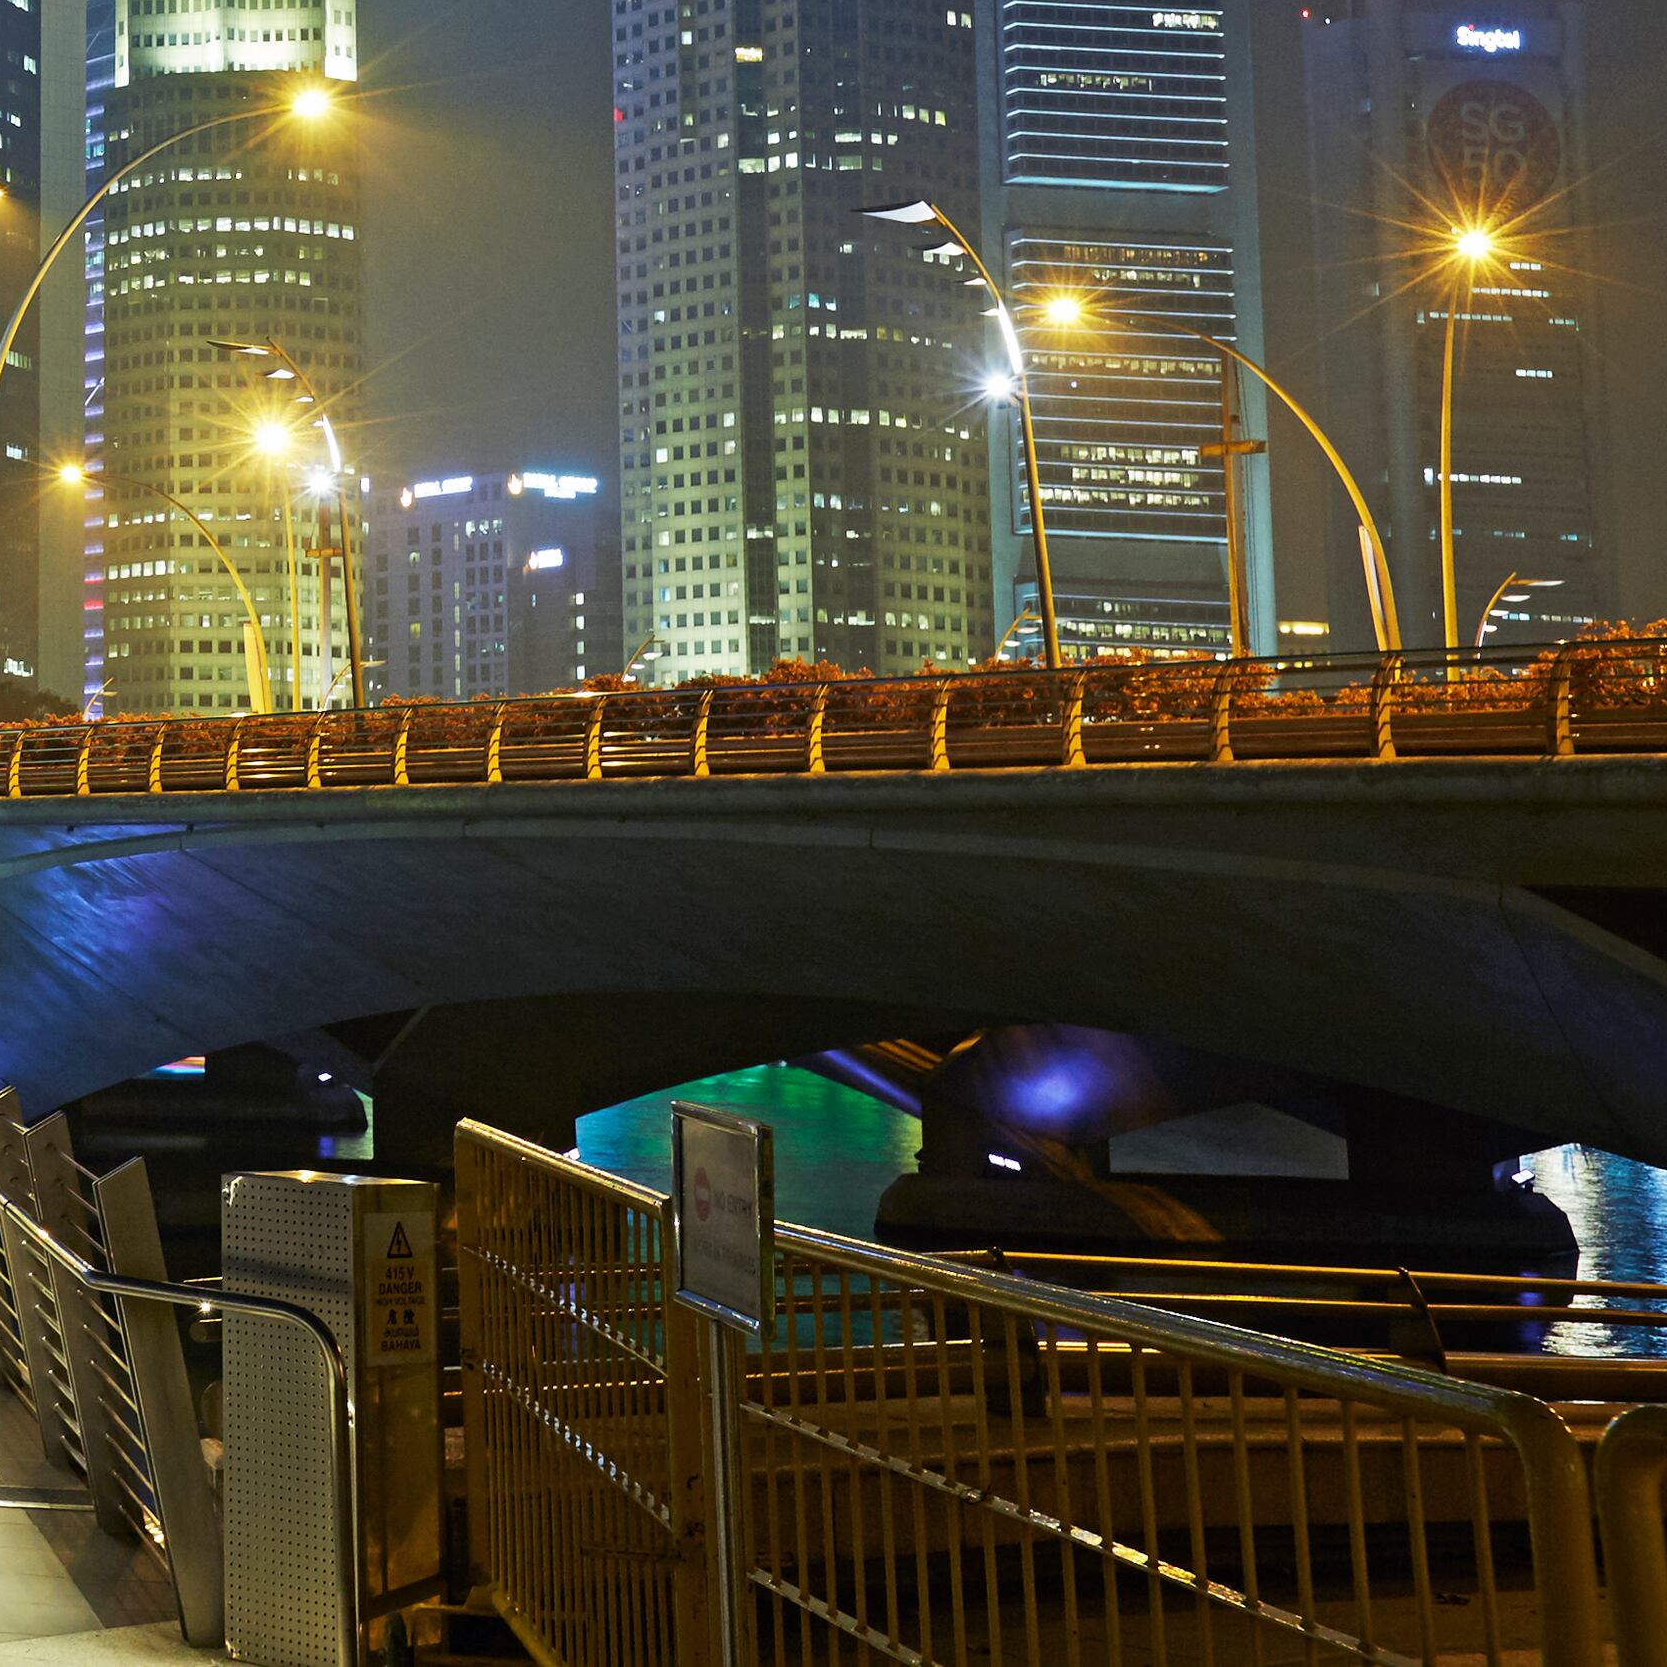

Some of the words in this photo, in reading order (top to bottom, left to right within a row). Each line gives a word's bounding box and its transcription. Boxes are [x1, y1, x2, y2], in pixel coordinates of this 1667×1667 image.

[1456, 24, 1521, 53] Singtel
[1461, 102, 1525, 144] SG
[386, 1266, 405, 1280] 415
[378, 1281, 422, 1295] DANGER
[380, 1339, 421, 1352] BAHAYA
